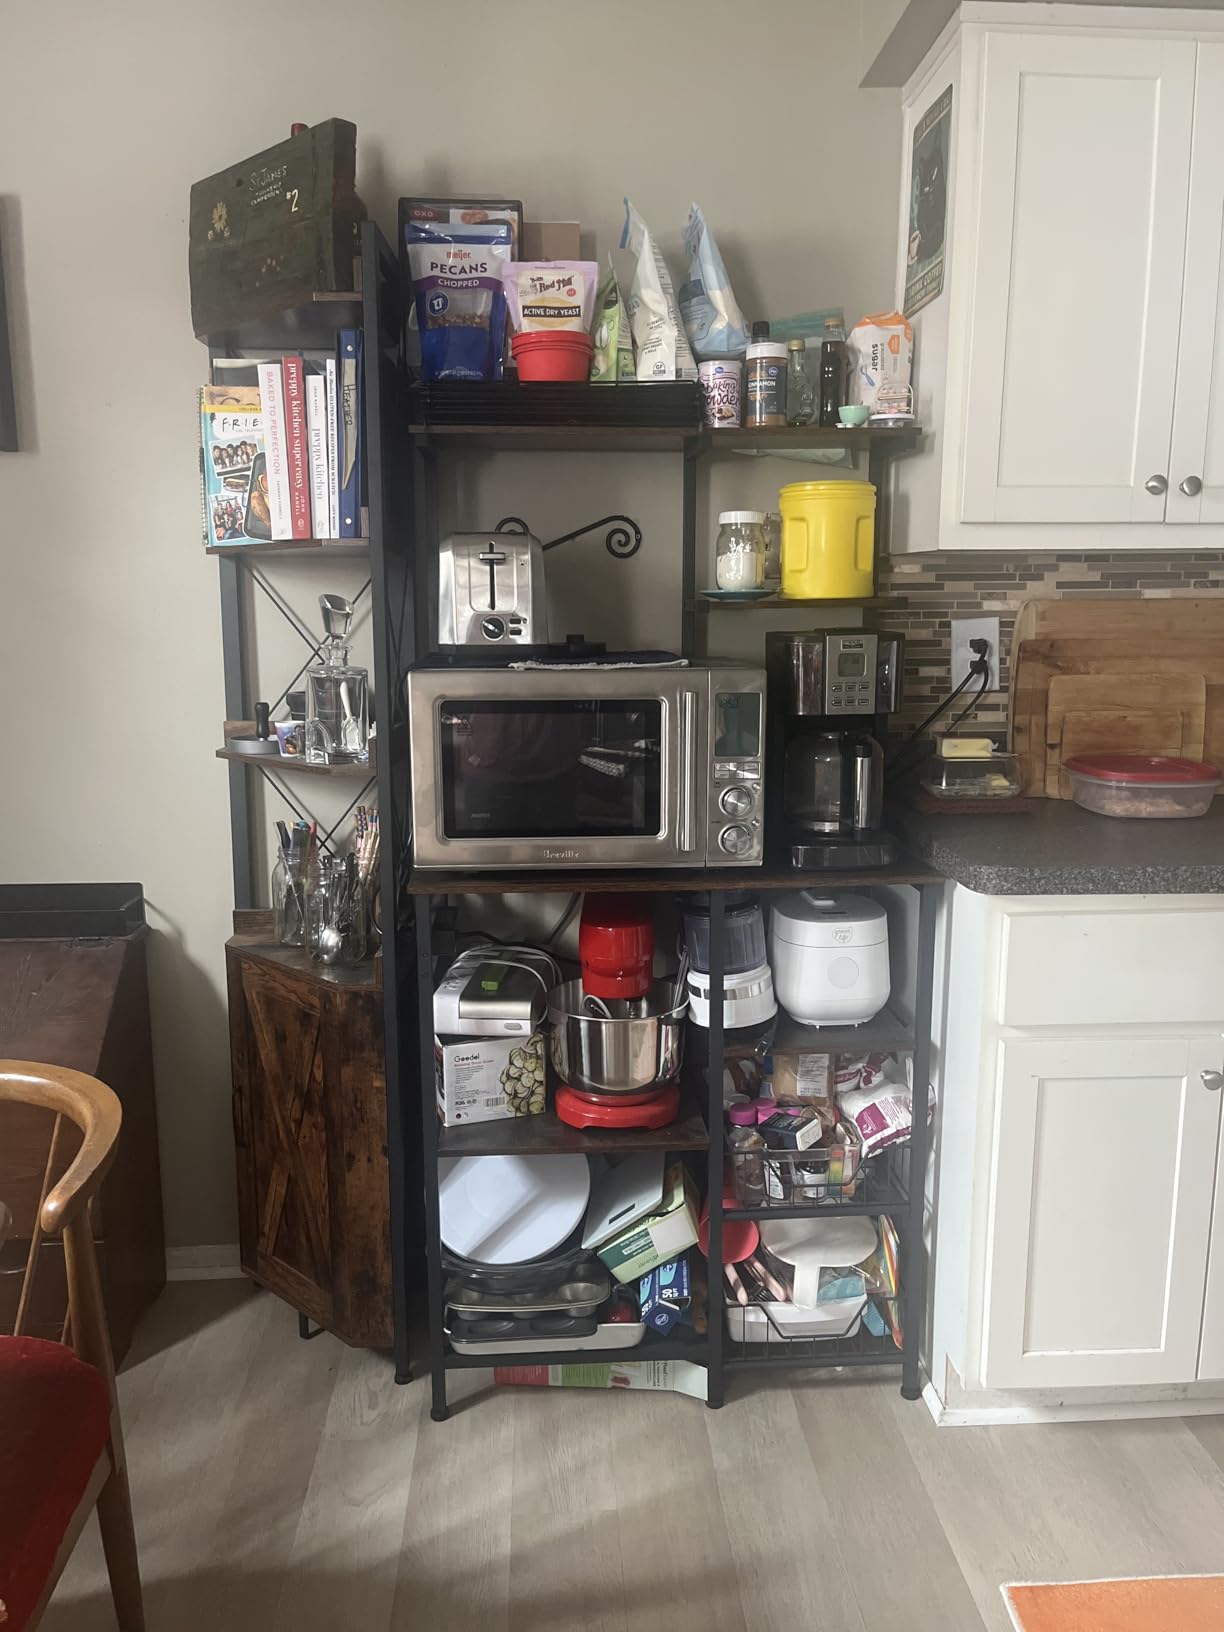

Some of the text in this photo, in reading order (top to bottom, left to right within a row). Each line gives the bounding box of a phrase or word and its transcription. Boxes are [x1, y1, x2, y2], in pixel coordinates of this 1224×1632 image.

[430, 262, 488, 275] PECANS
[438, 278, 480, 288] CHOPPED
[538, 281, 556, 294] Red
[523, 307, 580, 316] ACTIVE DRY YEAST
[871, 343, 879, 372] sugar
[265, 371, 275, 402] BAKED
[704, 380, 736, 394] baking
[269, 403, 277, 415] TO
[287, 363, 304, 489] preppy kitchen super easy
[269, 418, 281, 476] PERFECTION
[312, 428, 326, 500] preppy kitchen
[453, 1053, 480, 1063] Geedel
[662, 1288, 673, 1298] 50
